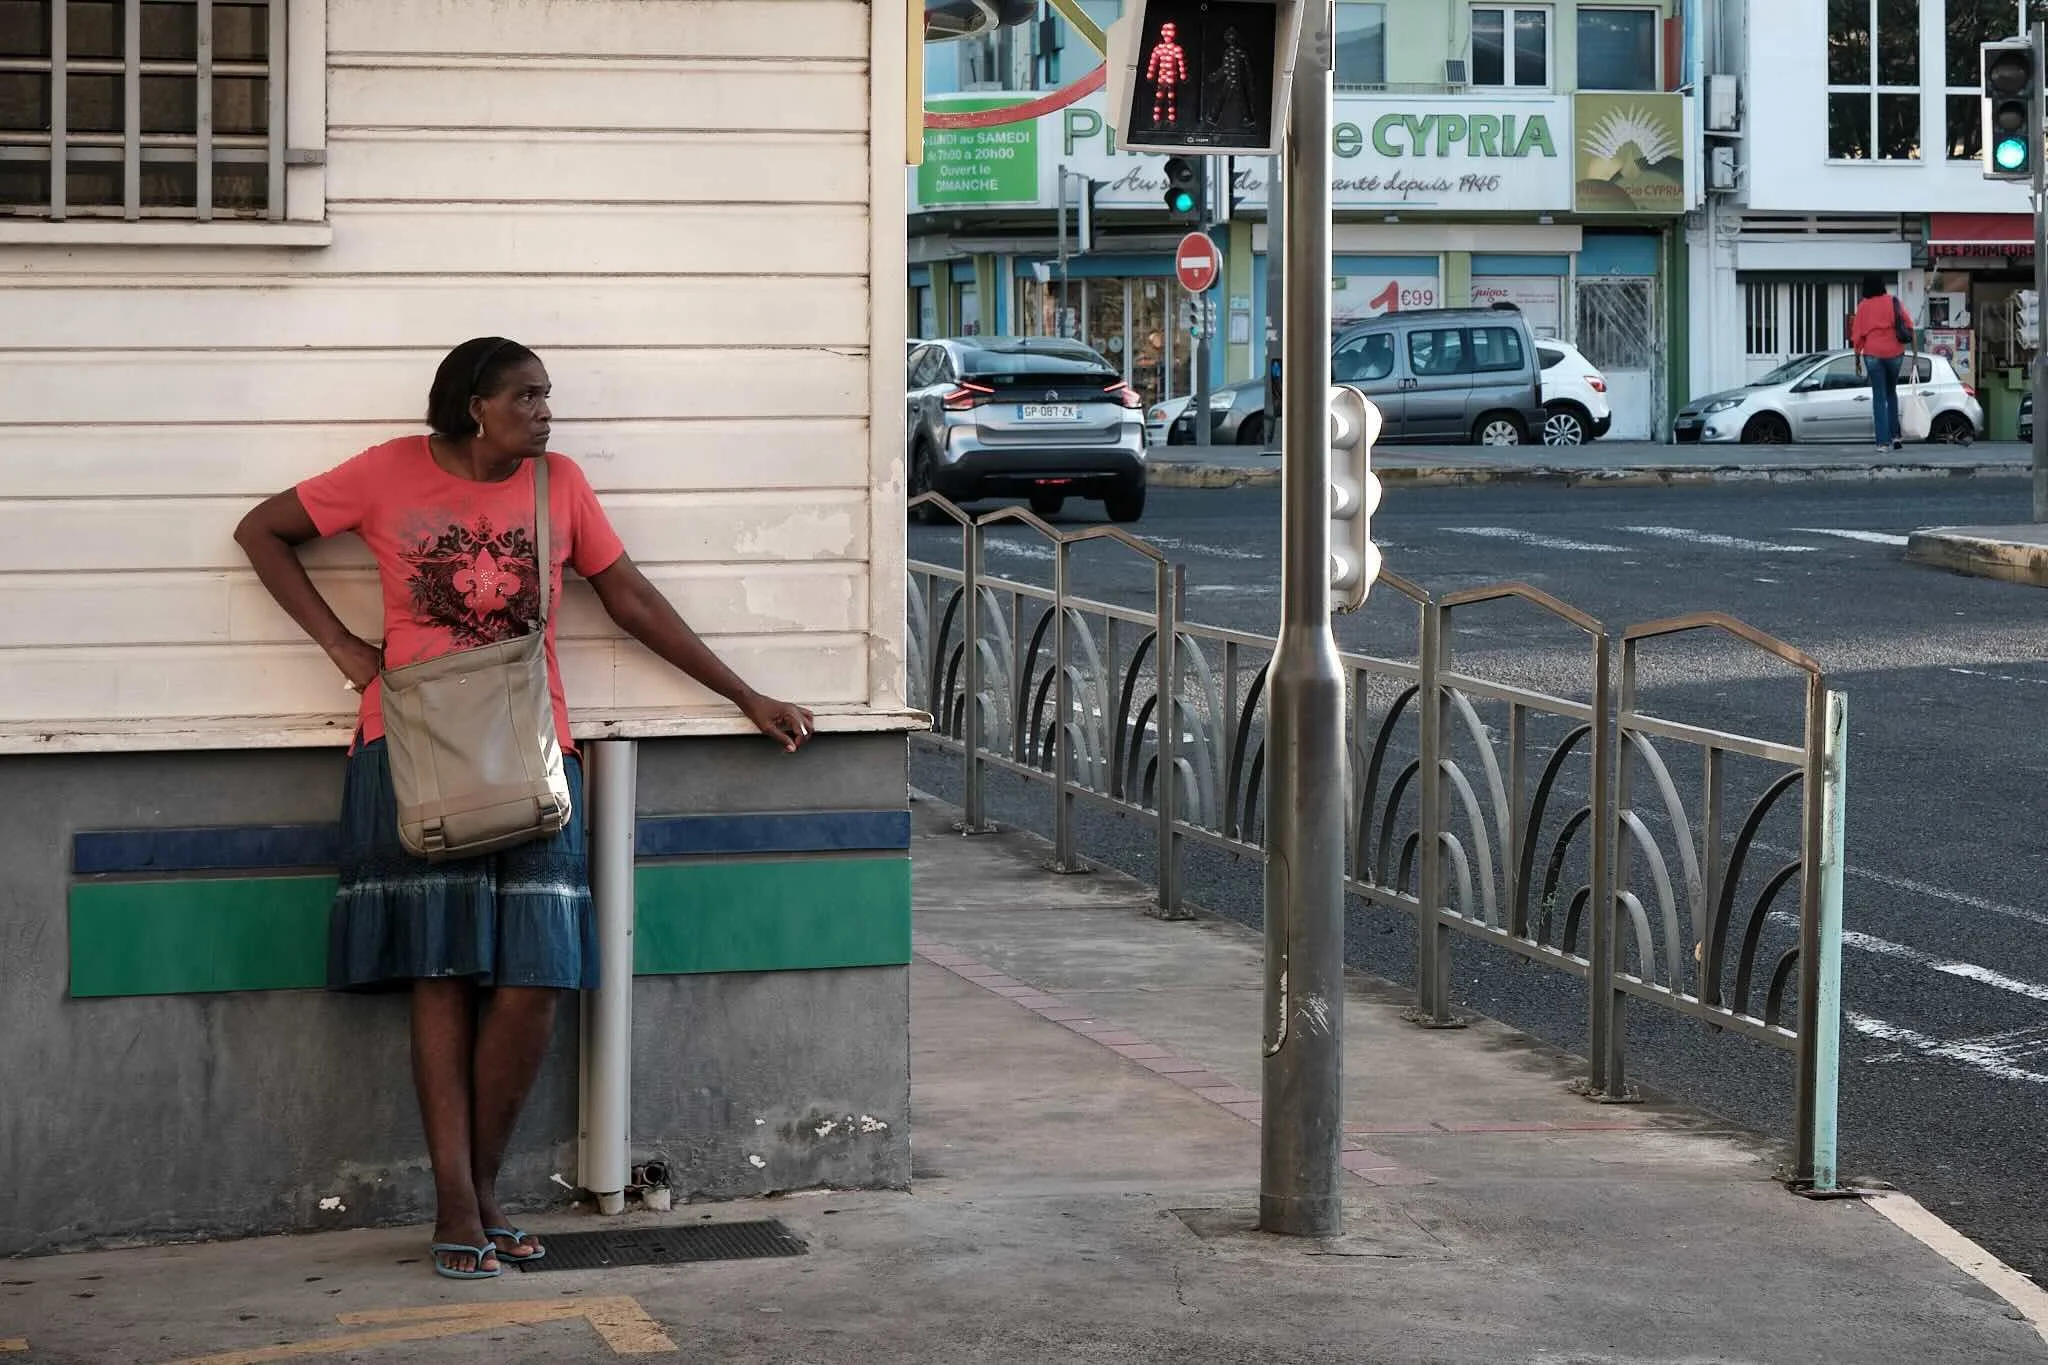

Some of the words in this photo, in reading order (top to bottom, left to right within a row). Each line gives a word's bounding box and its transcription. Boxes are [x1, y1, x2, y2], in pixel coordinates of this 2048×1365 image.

[977, 132, 1030, 145] SAMEDI
[1372, 112, 1557, 158] CYPRIA
[975, 147, 1015, 160] 20h00
[940, 164, 976, 177] Ouvert
[979, 163, 992, 175] le
[935, 178, 999, 193] DIMANCHE
[1332, 174, 1381, 192] anté
[1383, 170, 1455, 201] depuis
[1935, 244, 1957, 257] LES
